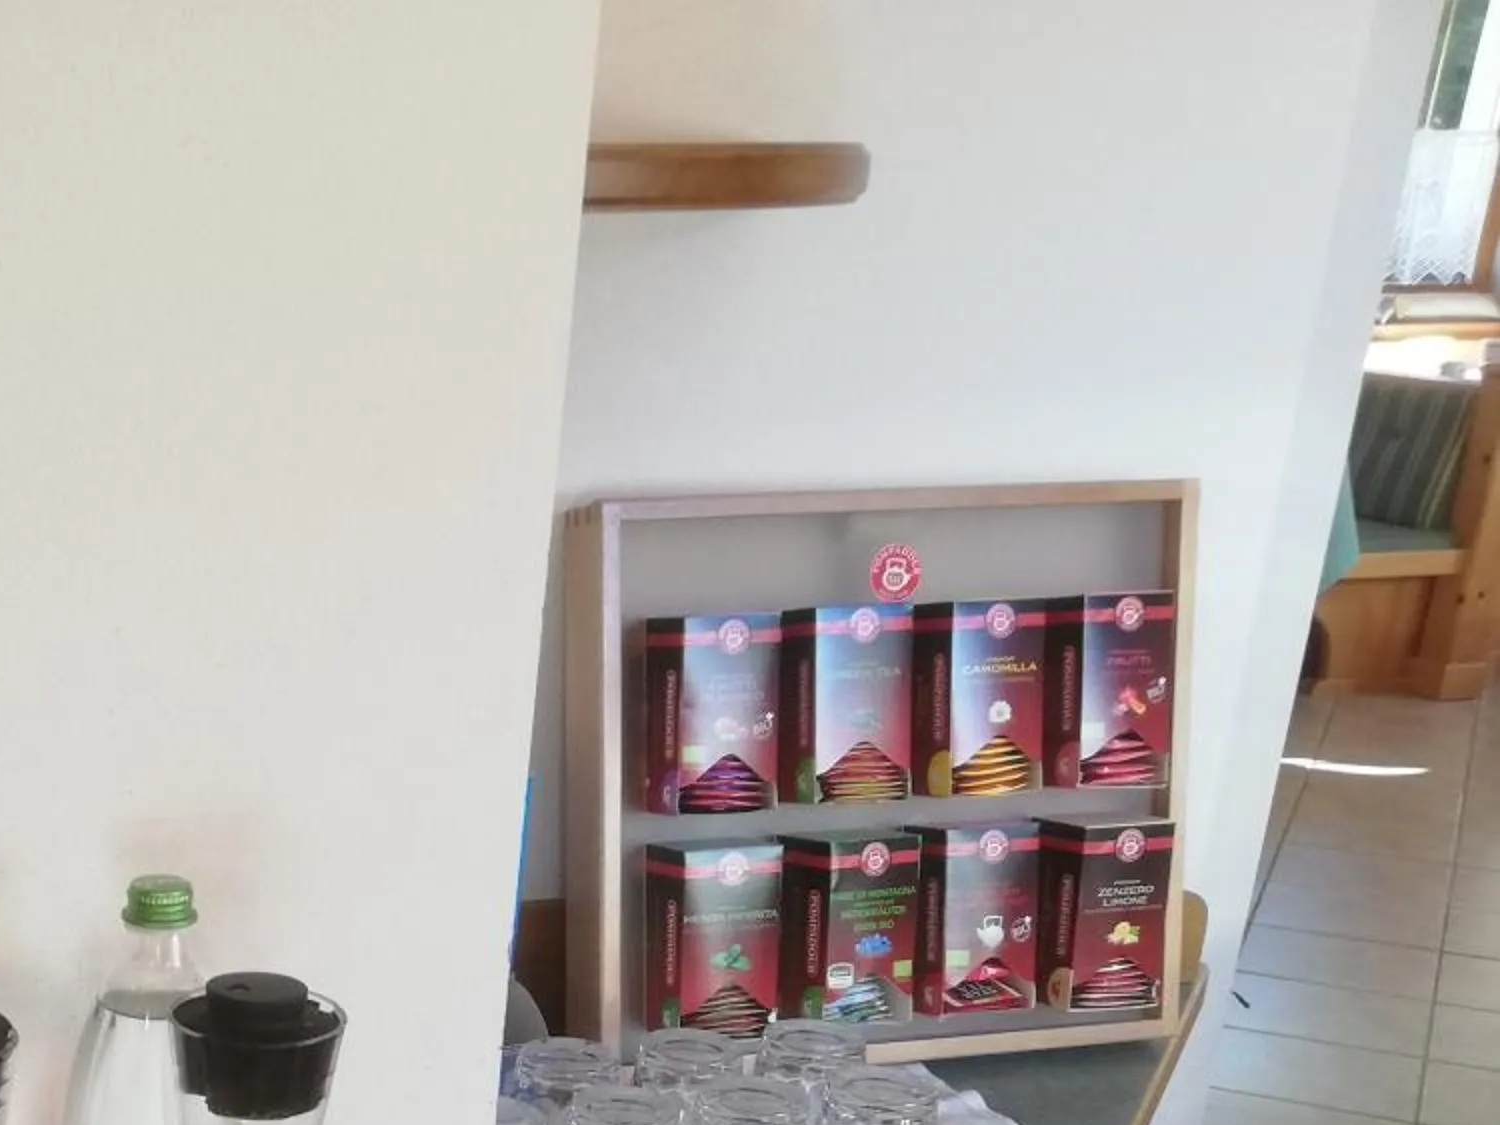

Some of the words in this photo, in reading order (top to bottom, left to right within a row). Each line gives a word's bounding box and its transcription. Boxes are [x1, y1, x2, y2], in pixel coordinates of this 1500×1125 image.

[962, 661, 1038, 676] CAMOMILLA
[1097, 885, 1155, 897] ZENZERO
[1103, 896, 1148, 907] LIMONE
